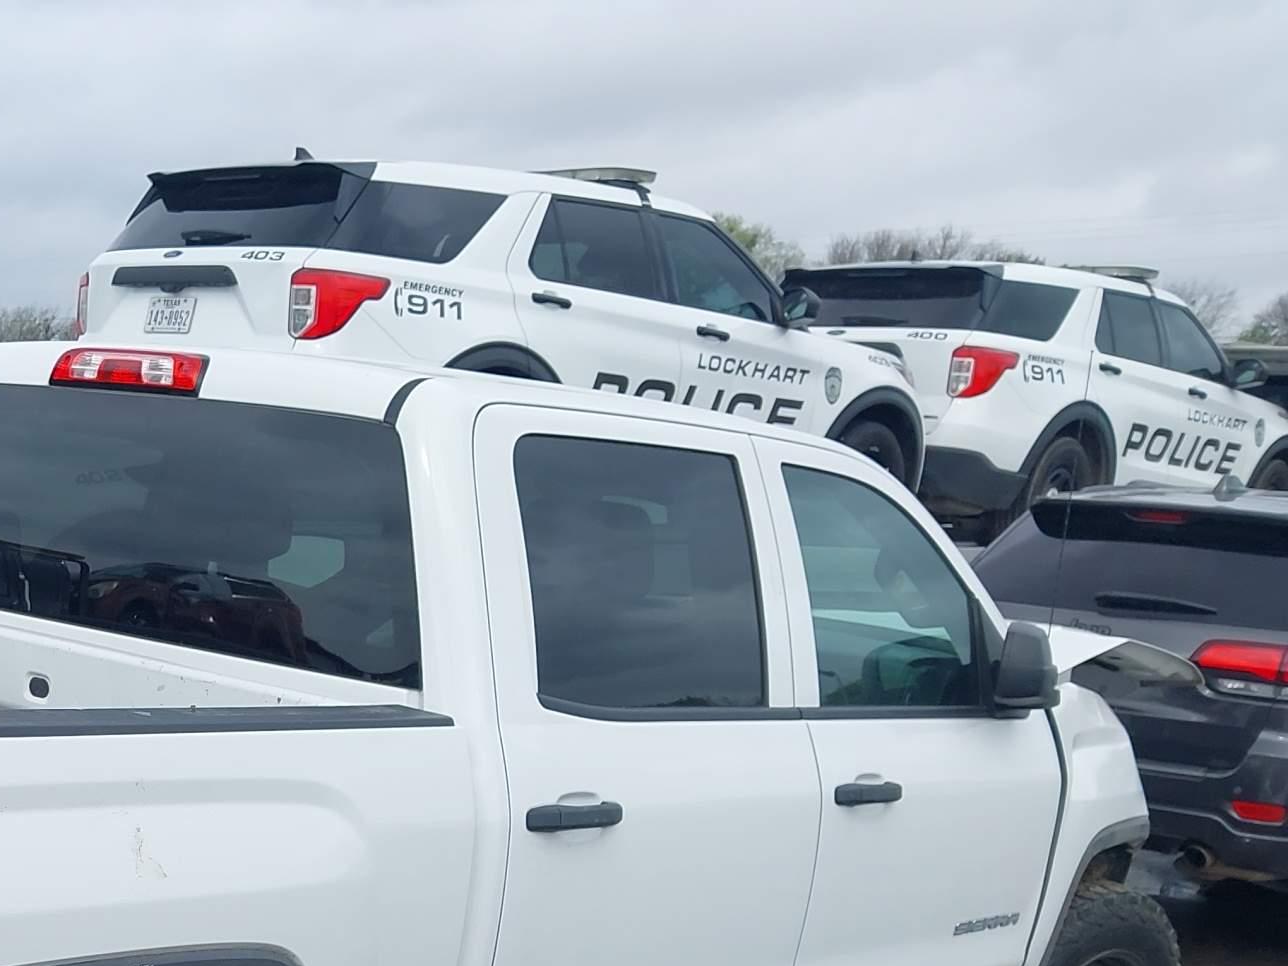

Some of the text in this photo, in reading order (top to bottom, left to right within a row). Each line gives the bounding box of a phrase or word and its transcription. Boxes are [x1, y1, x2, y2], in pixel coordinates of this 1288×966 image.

[241, 250, 285, 261] 403
[403, 281, 464, 298] EMERGENCY
[407, 294, 462, 320] 911
[907, 332, 948, 341] 400
[697, 353, 811, 385] LOCKHART
[1031, 365, 1066, 384] 911
[1187, 408, 1248, 432] LOCKHART
[1122, 423, 1242, 475] POLICE
